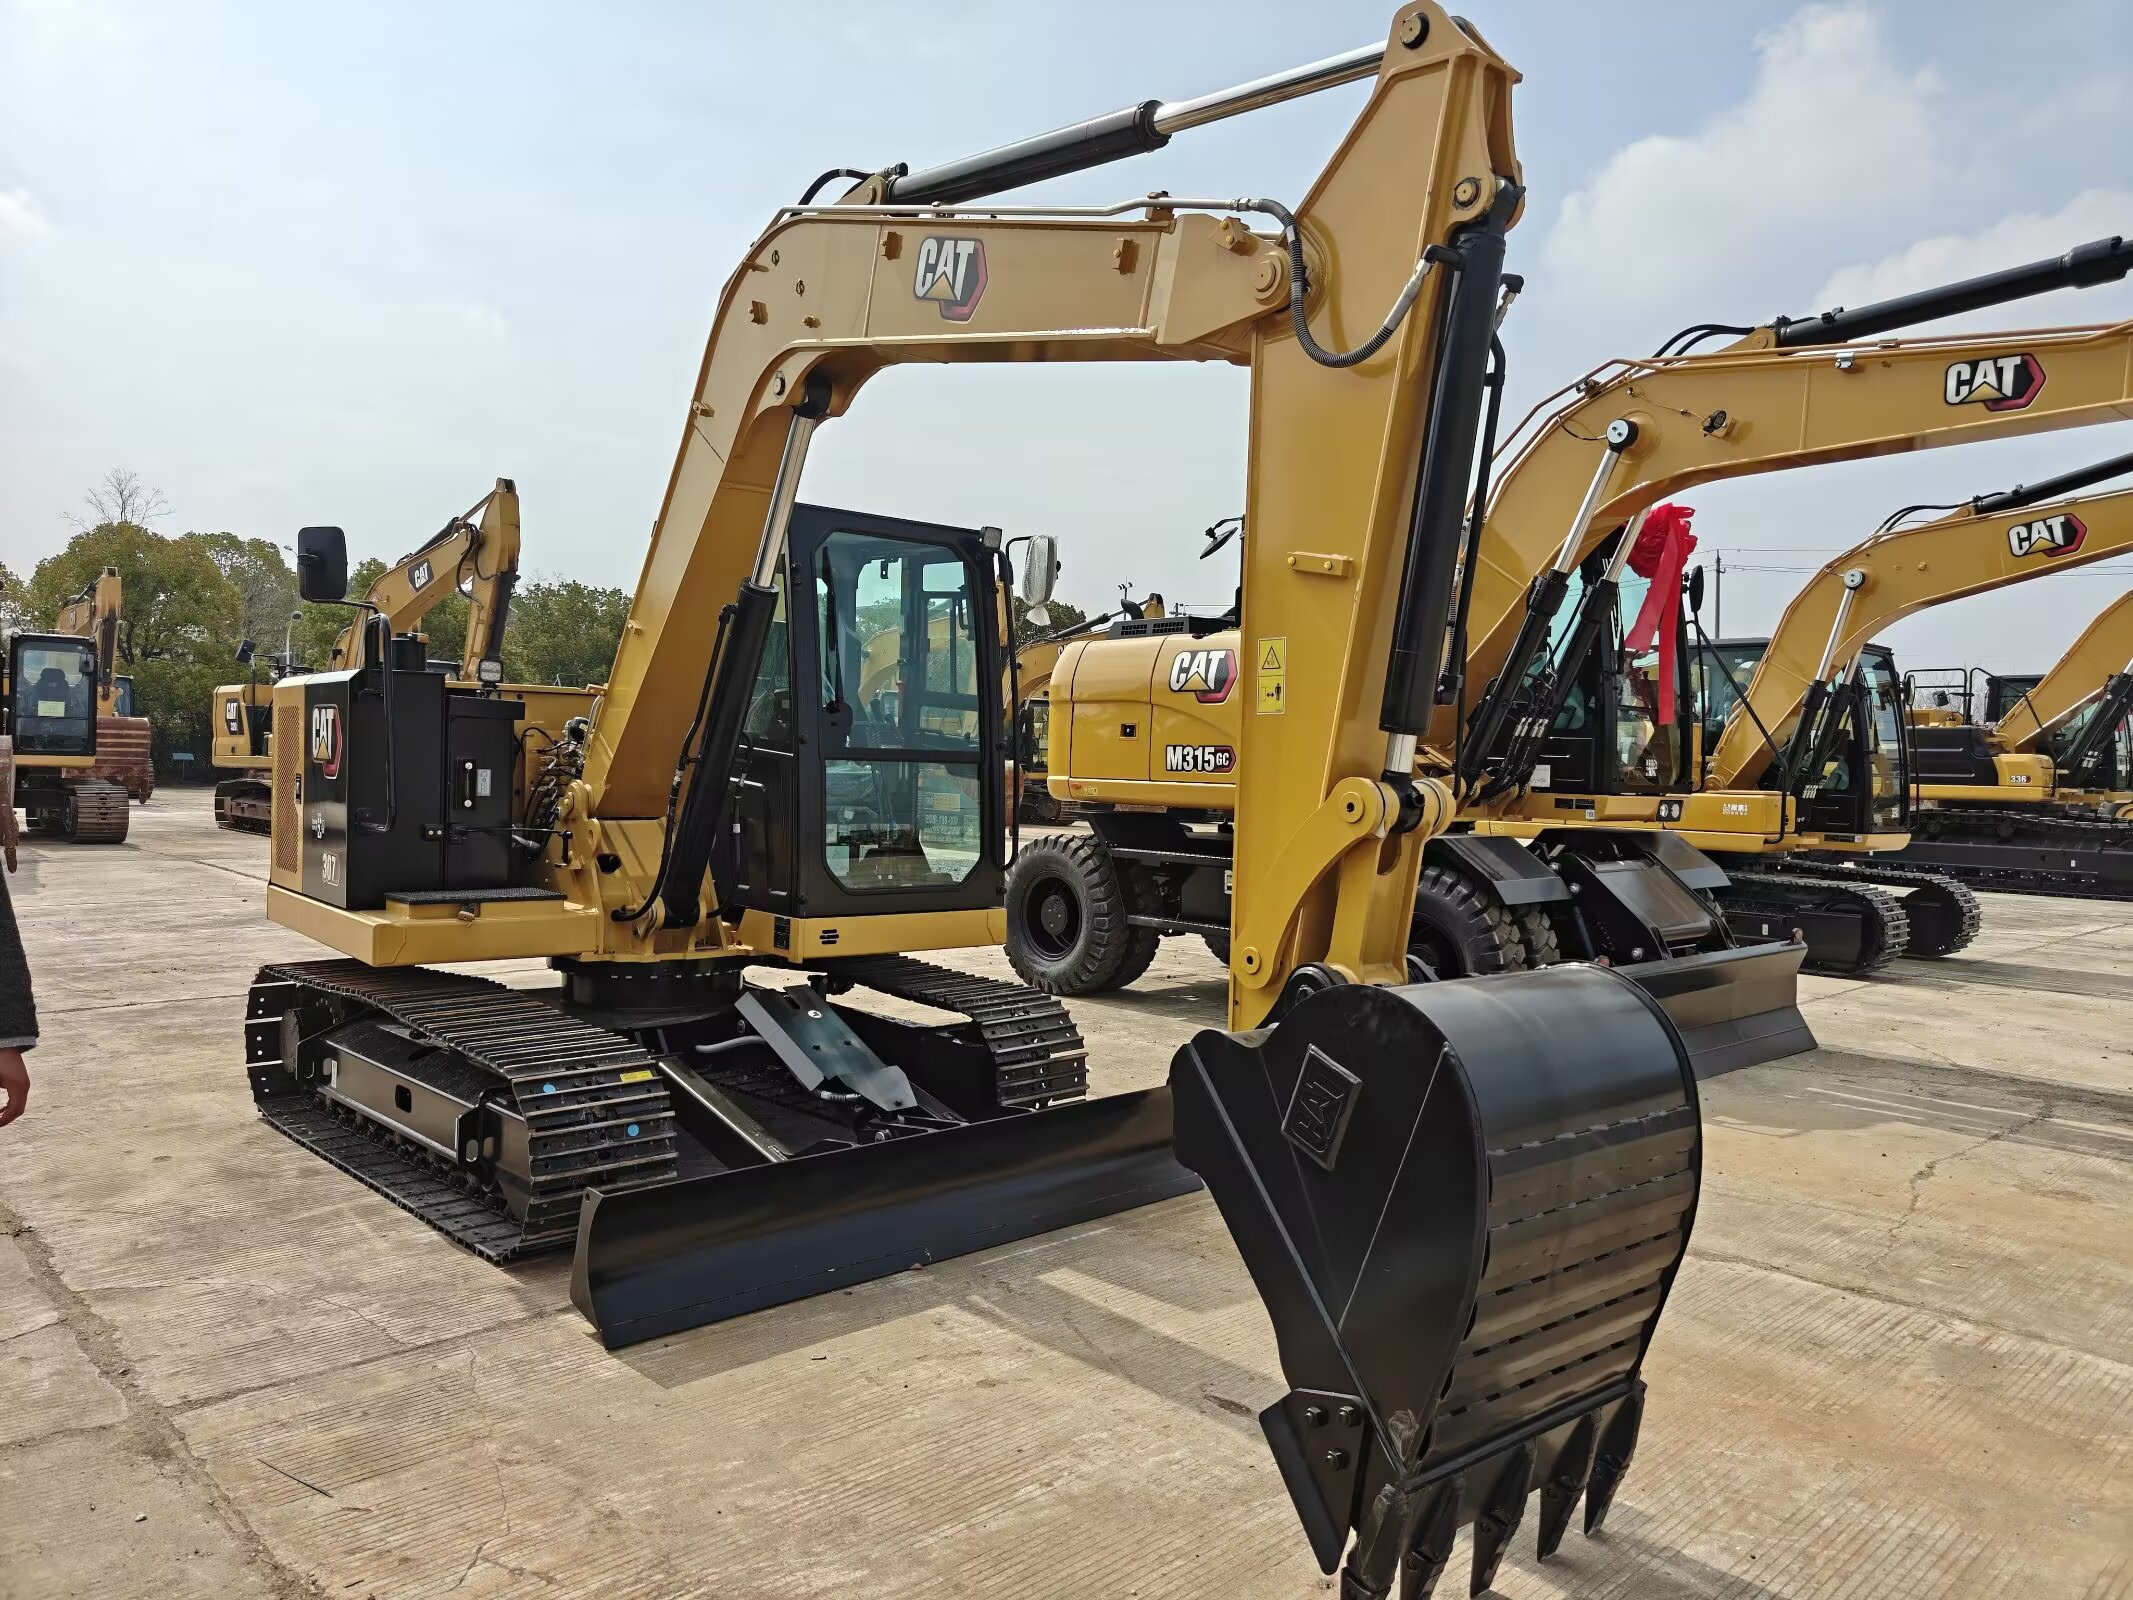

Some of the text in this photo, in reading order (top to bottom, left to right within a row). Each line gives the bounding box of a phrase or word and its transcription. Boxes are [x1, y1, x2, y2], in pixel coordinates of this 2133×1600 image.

[914, 238, 975, 301] CAT
[1946, 355, 2022, 404] CAT
[2008, 515, 2065, 556] CAT
[414, 561, 429, 589] CAT
[1169, 650, 1227, 691] CAT
[226, 702, 238, 720] CAT
[312, 707, 335, 760] CAT
[1166, 746, 1230, 771] M315 GC
[2010, 775, 2027, 783] 336
[322, 853, 336, 881] 307
[1292, 1061, 1346, 1152] CAT
